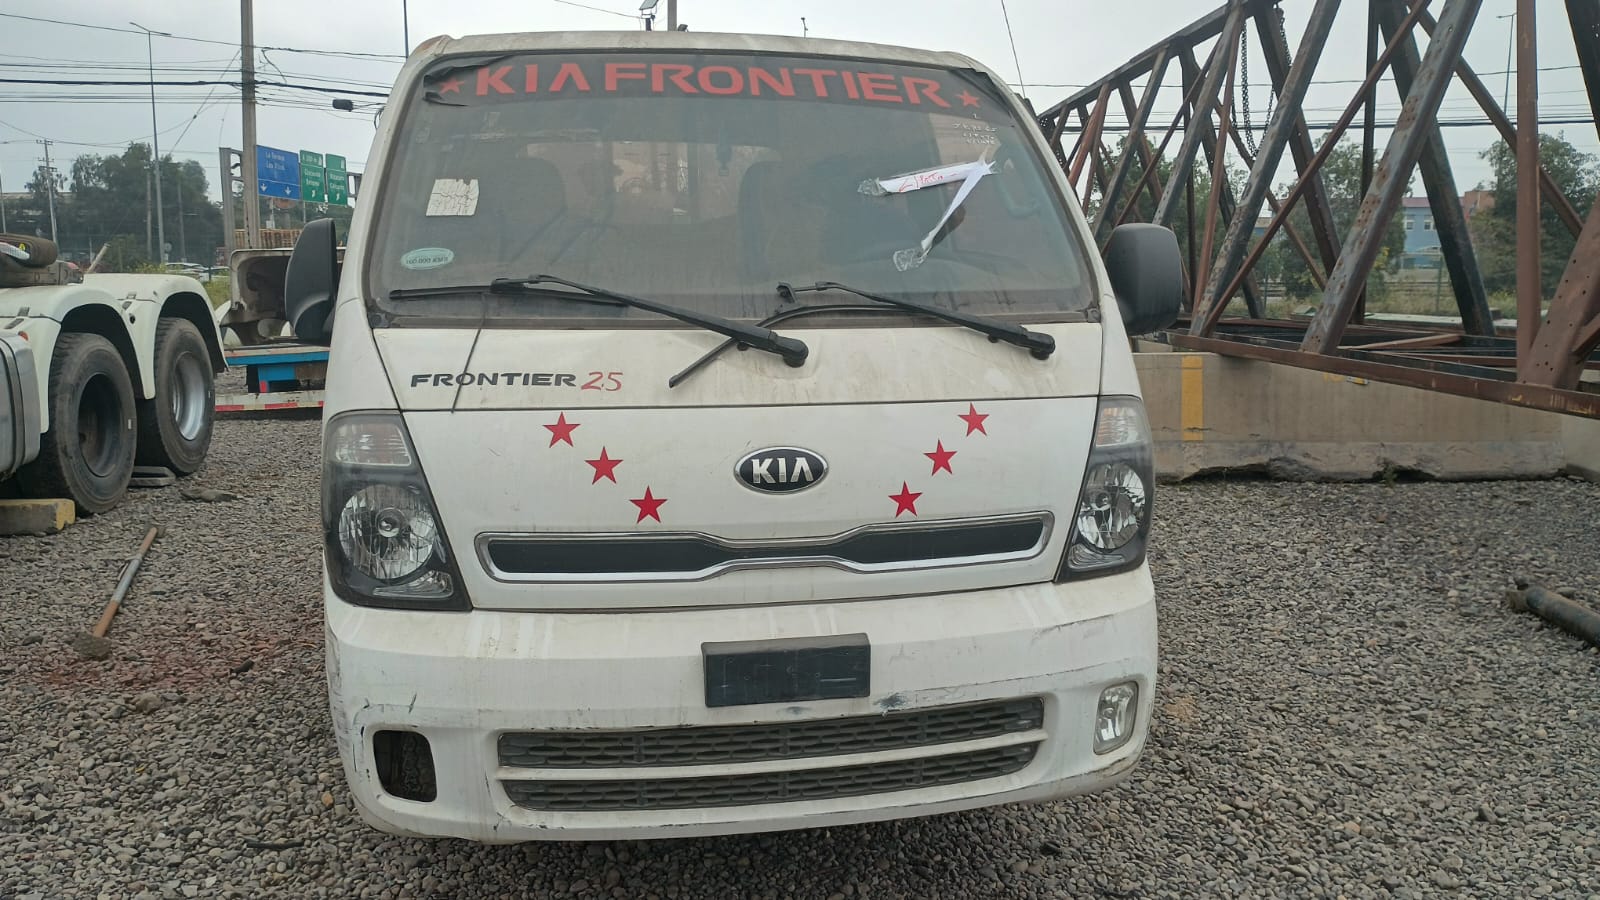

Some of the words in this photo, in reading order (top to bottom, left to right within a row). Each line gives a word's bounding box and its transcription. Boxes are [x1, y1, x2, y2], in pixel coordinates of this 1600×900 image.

[475, 63, 591, 96] KIA
[604, 63, 951, 108] FRONTIER
[410, 373, 577, 388] FRONTIER
[750, 456, 815, 484] KIA
